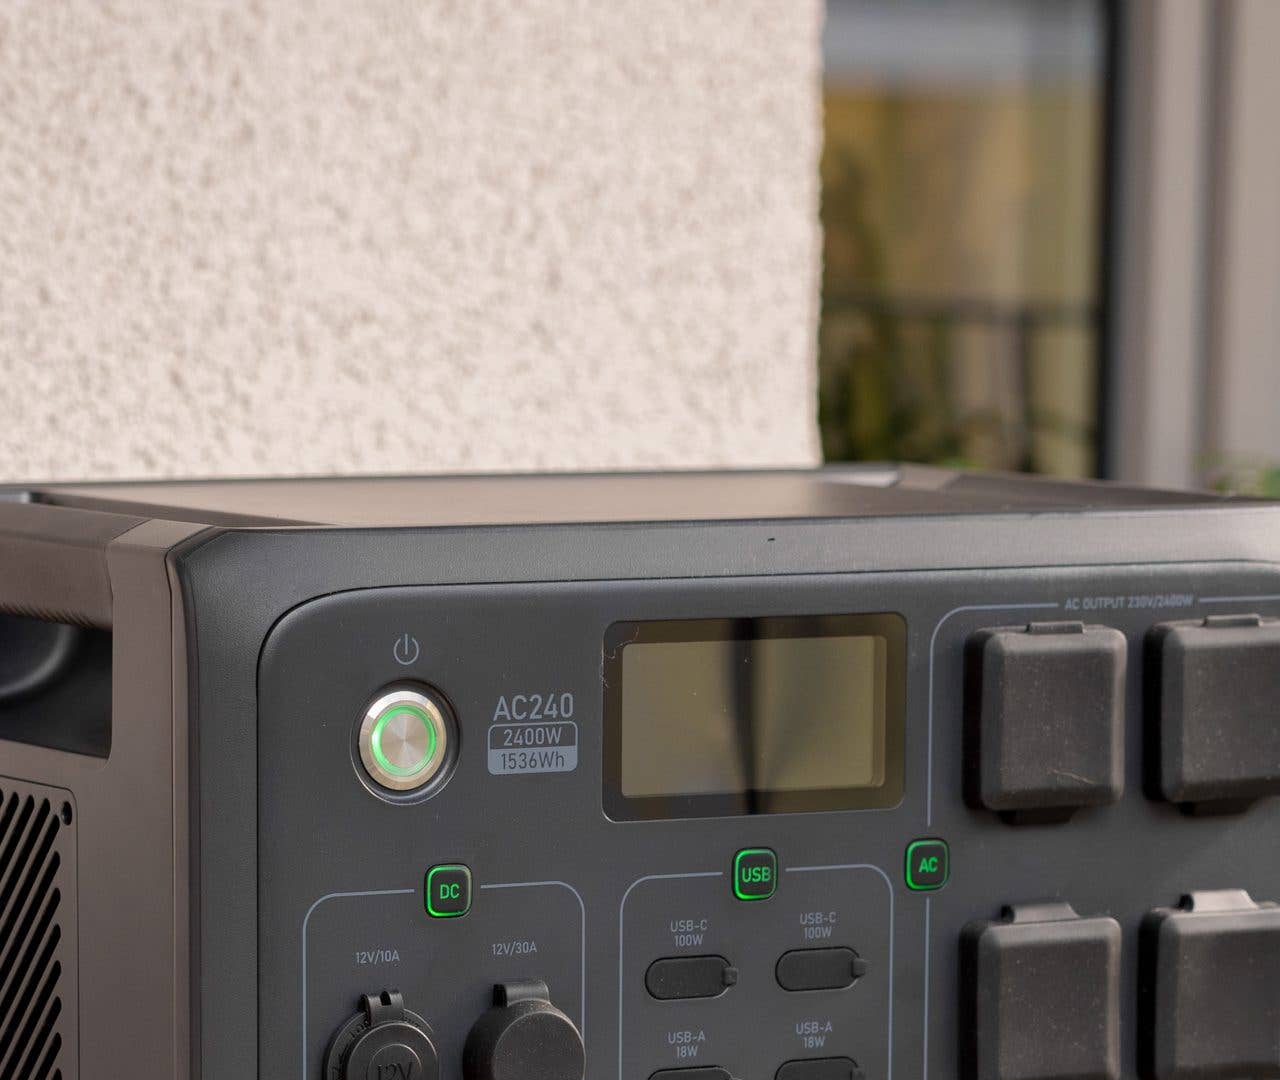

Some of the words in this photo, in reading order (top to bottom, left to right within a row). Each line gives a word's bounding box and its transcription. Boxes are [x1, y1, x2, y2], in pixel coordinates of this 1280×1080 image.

[1064, 597, 1080, 610] AC
[1083, 596, 1125, 609] OUTPUT
[493, 693, 574, 721] AC240
[503, 727, 562, 746] 2400W
[501, 751, 565, 770] 1536Wh
[919, 857, 938, 873] AC
[741, 866, 771, 883] USB
[439, 883, 460, 899] DC
[800, 911, 837, 925] USB-C
[670, 919, 708, 932] USB-C
[804, 926, 833, 939] 100W
[674, 934, 703, 947] 100W
[492, 941, 537, 956] 12V/30A
[355, 949, 400, 965] 12V/10A
[795, 1021, 833, 1035] USB-A
[668, 1031, 706, 1044] USB-A
[803, 1036, 825, 1049] 18W
[676, 1045, 698, 1058] 18W
